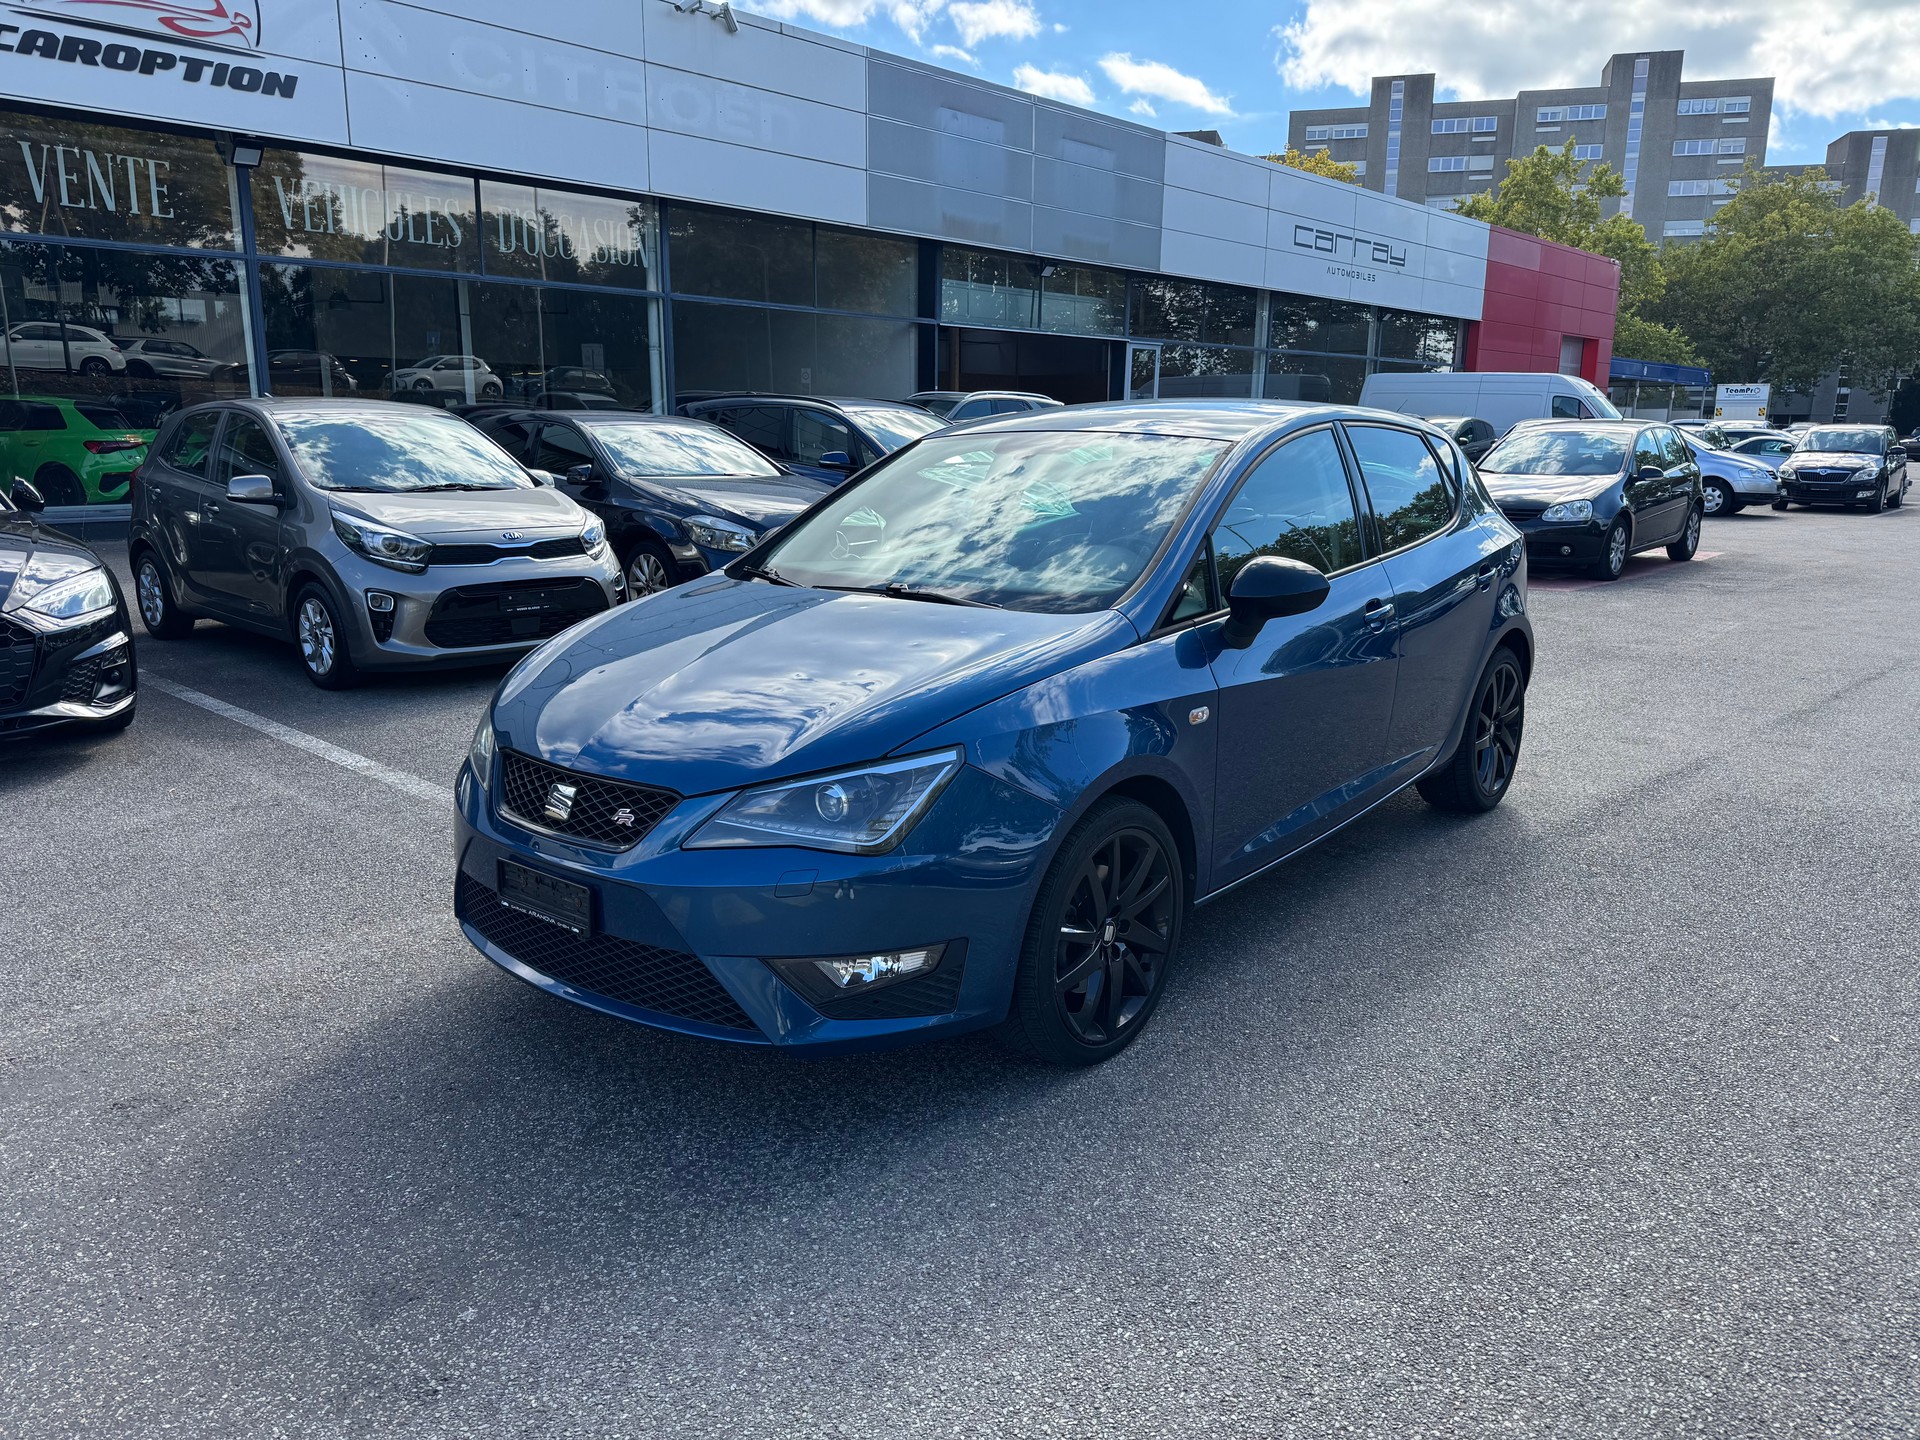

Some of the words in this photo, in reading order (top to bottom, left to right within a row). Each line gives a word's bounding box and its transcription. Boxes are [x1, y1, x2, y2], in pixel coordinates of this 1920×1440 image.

[16, 140, 175, 219] VENTE
[1326, 265, 1376, 282] AUTOMOBILES
[502, 531, 523, 539] KIA
